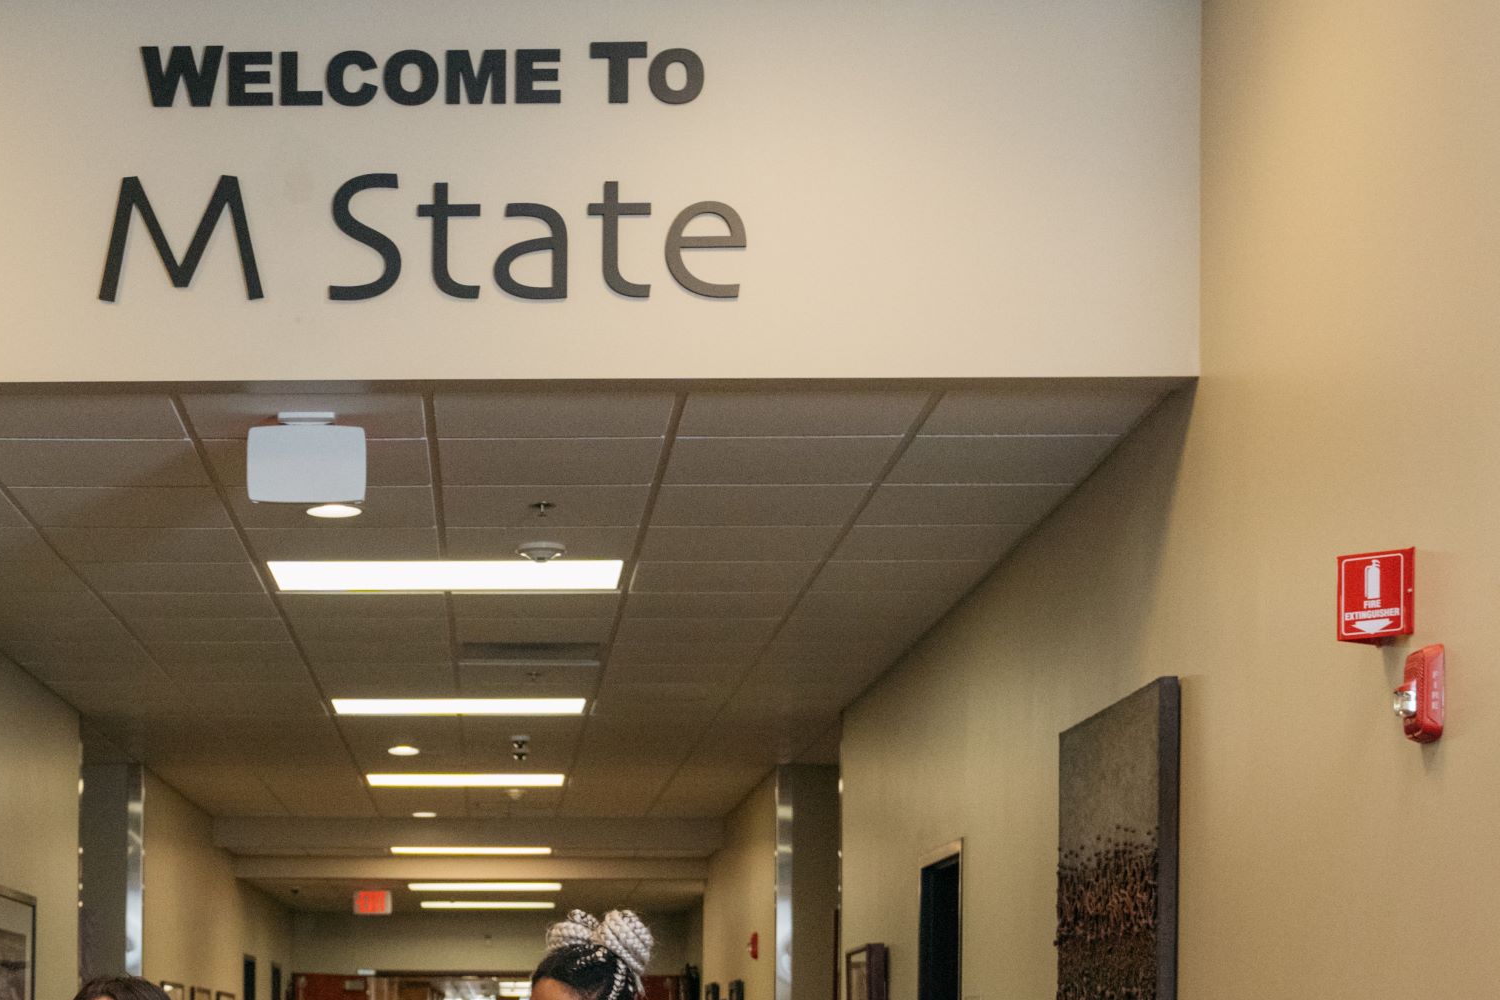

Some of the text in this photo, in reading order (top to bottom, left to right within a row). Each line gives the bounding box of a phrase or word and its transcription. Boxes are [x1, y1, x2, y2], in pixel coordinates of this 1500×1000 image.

[98, 172, 747, 303] M State
[1363, 599, 1381, 609] FIRE
[1344, 607, 1401, 621] EXTINGUISHER
